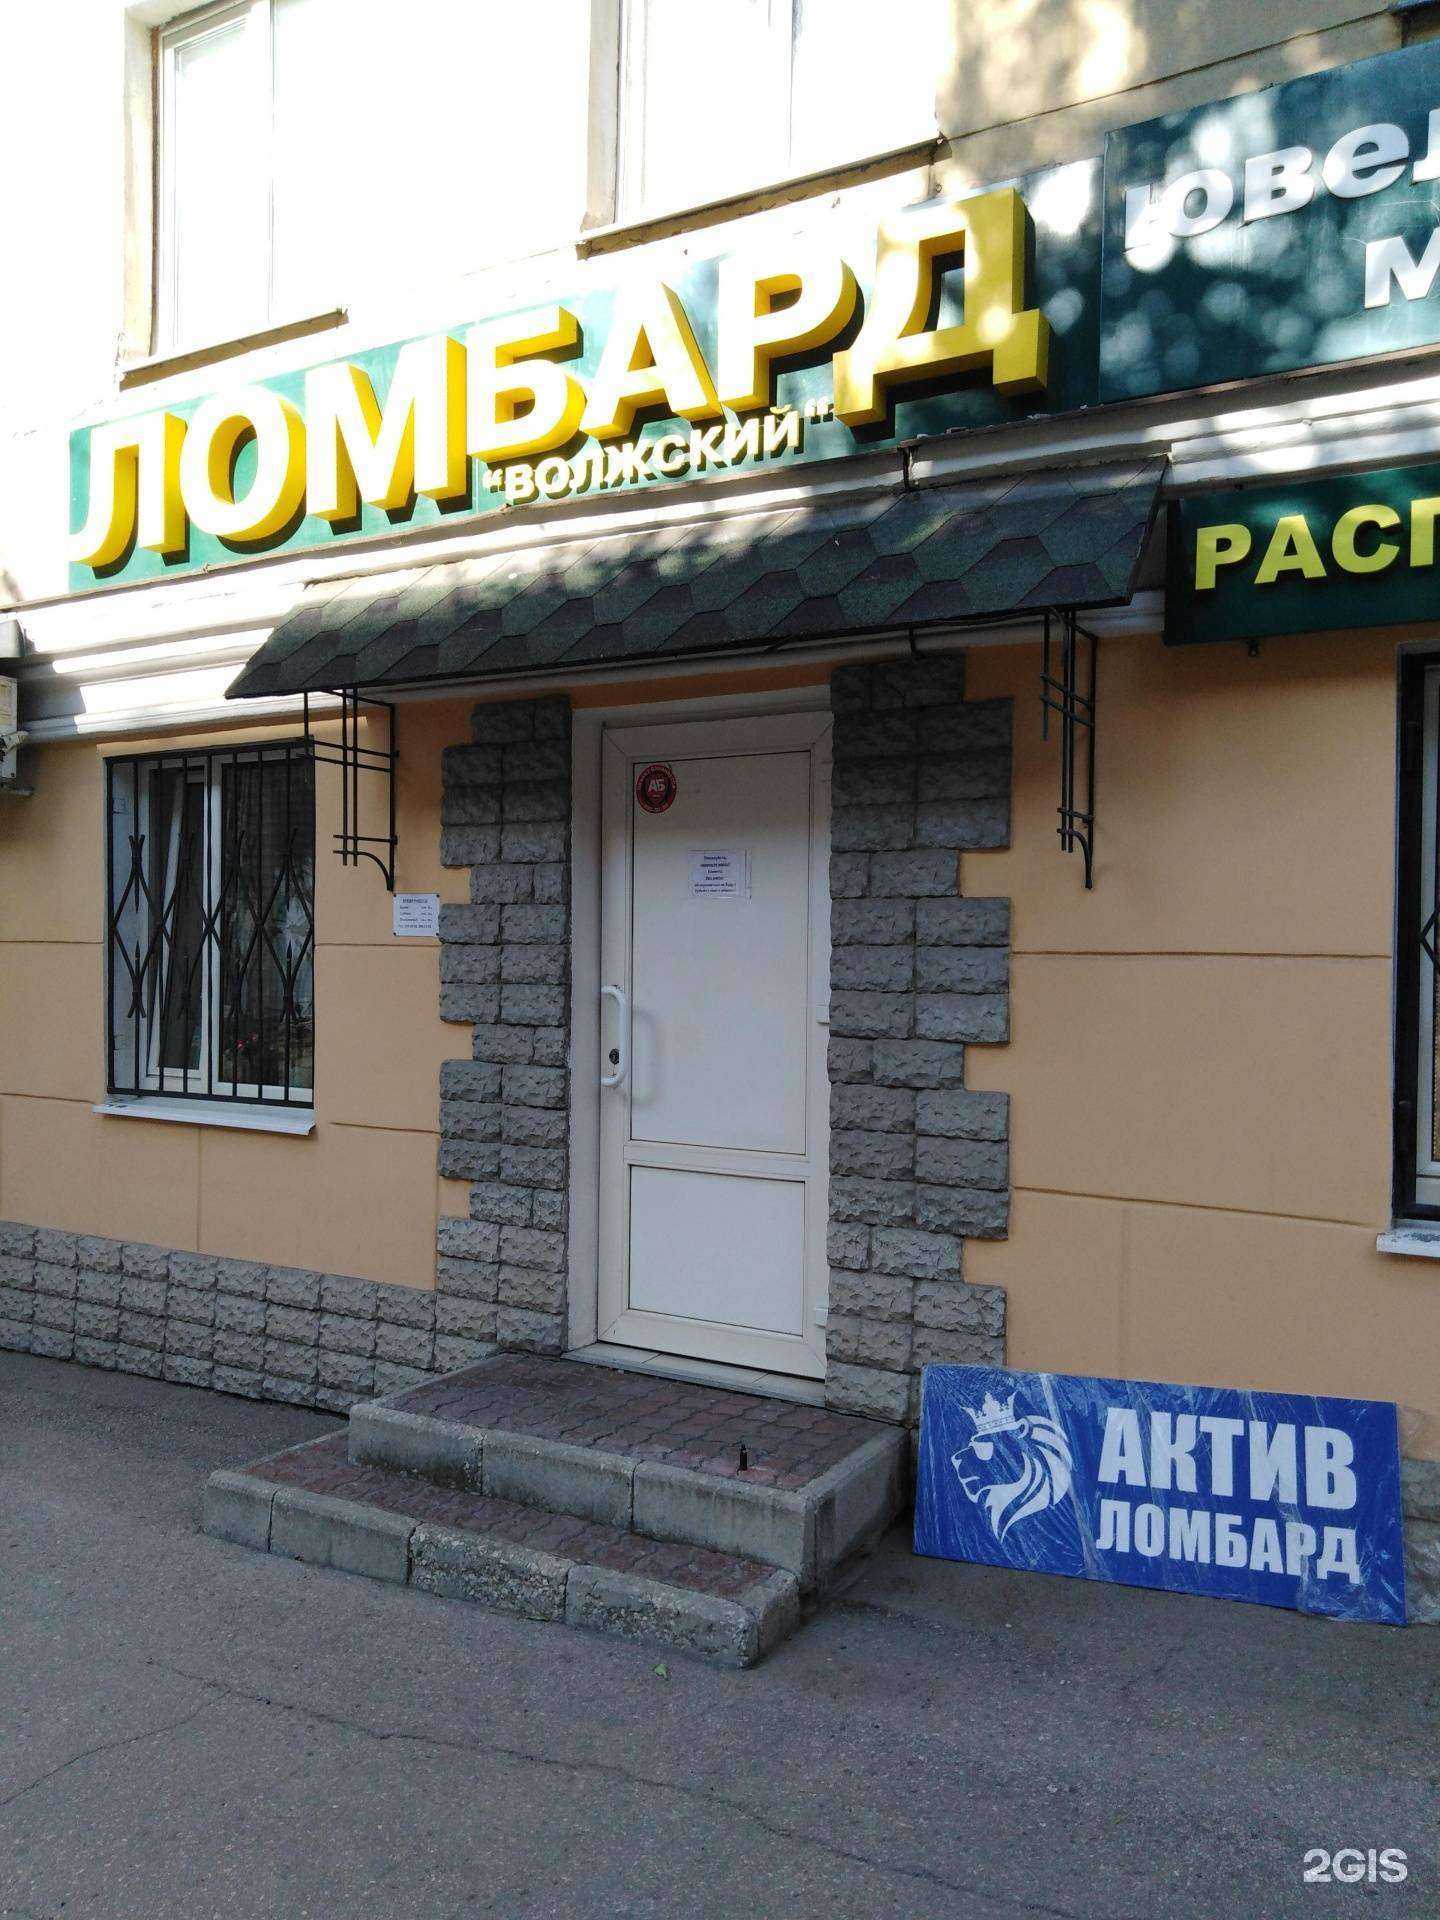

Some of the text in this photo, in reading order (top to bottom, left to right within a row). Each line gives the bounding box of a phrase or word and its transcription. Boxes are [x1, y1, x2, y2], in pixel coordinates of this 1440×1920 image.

[68, 188, 1049, 568] ЛОМБАРД
[1097, 1407, 1357, 1510] АКТИВ
[1096, 1498, 1360, 1585] ЛОМБАРД
